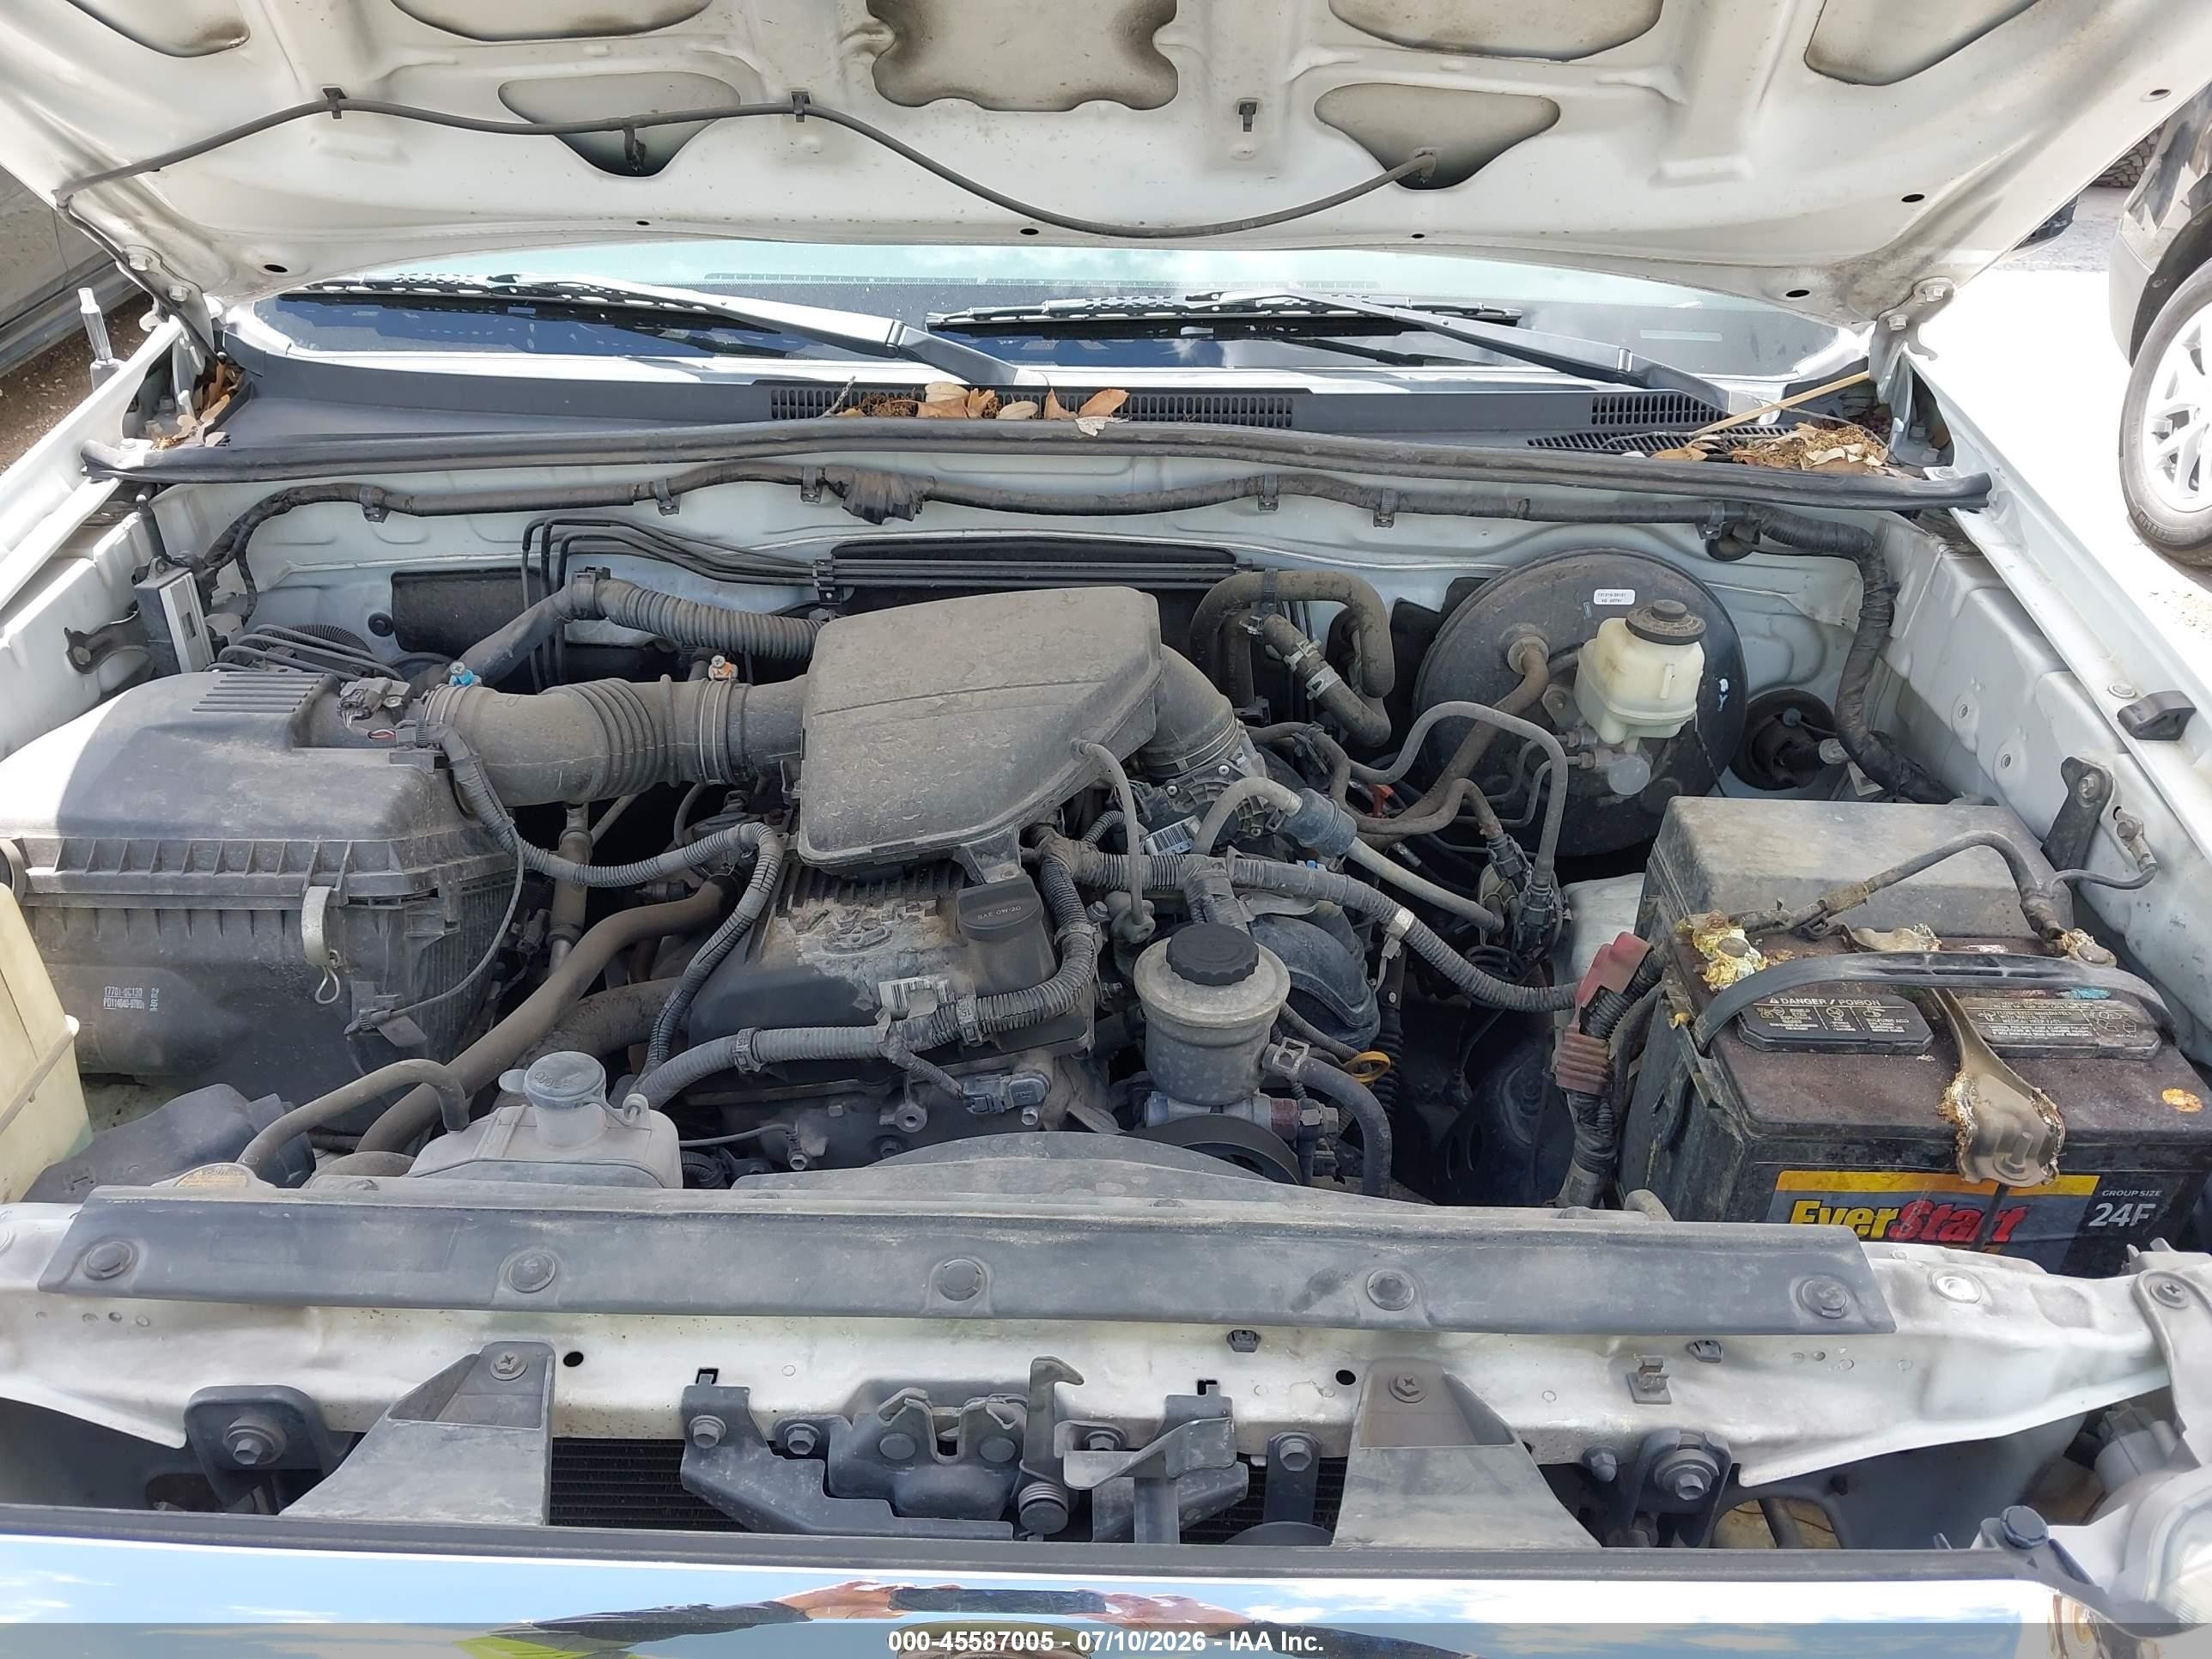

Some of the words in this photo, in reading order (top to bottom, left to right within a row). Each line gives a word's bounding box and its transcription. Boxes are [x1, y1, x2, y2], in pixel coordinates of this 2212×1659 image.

[1779, 997, 1827, 1006] DANGER
[1790, 1200, 2029, 1242] EverStat
[2087, 1203, 2156, 1228] 24F
